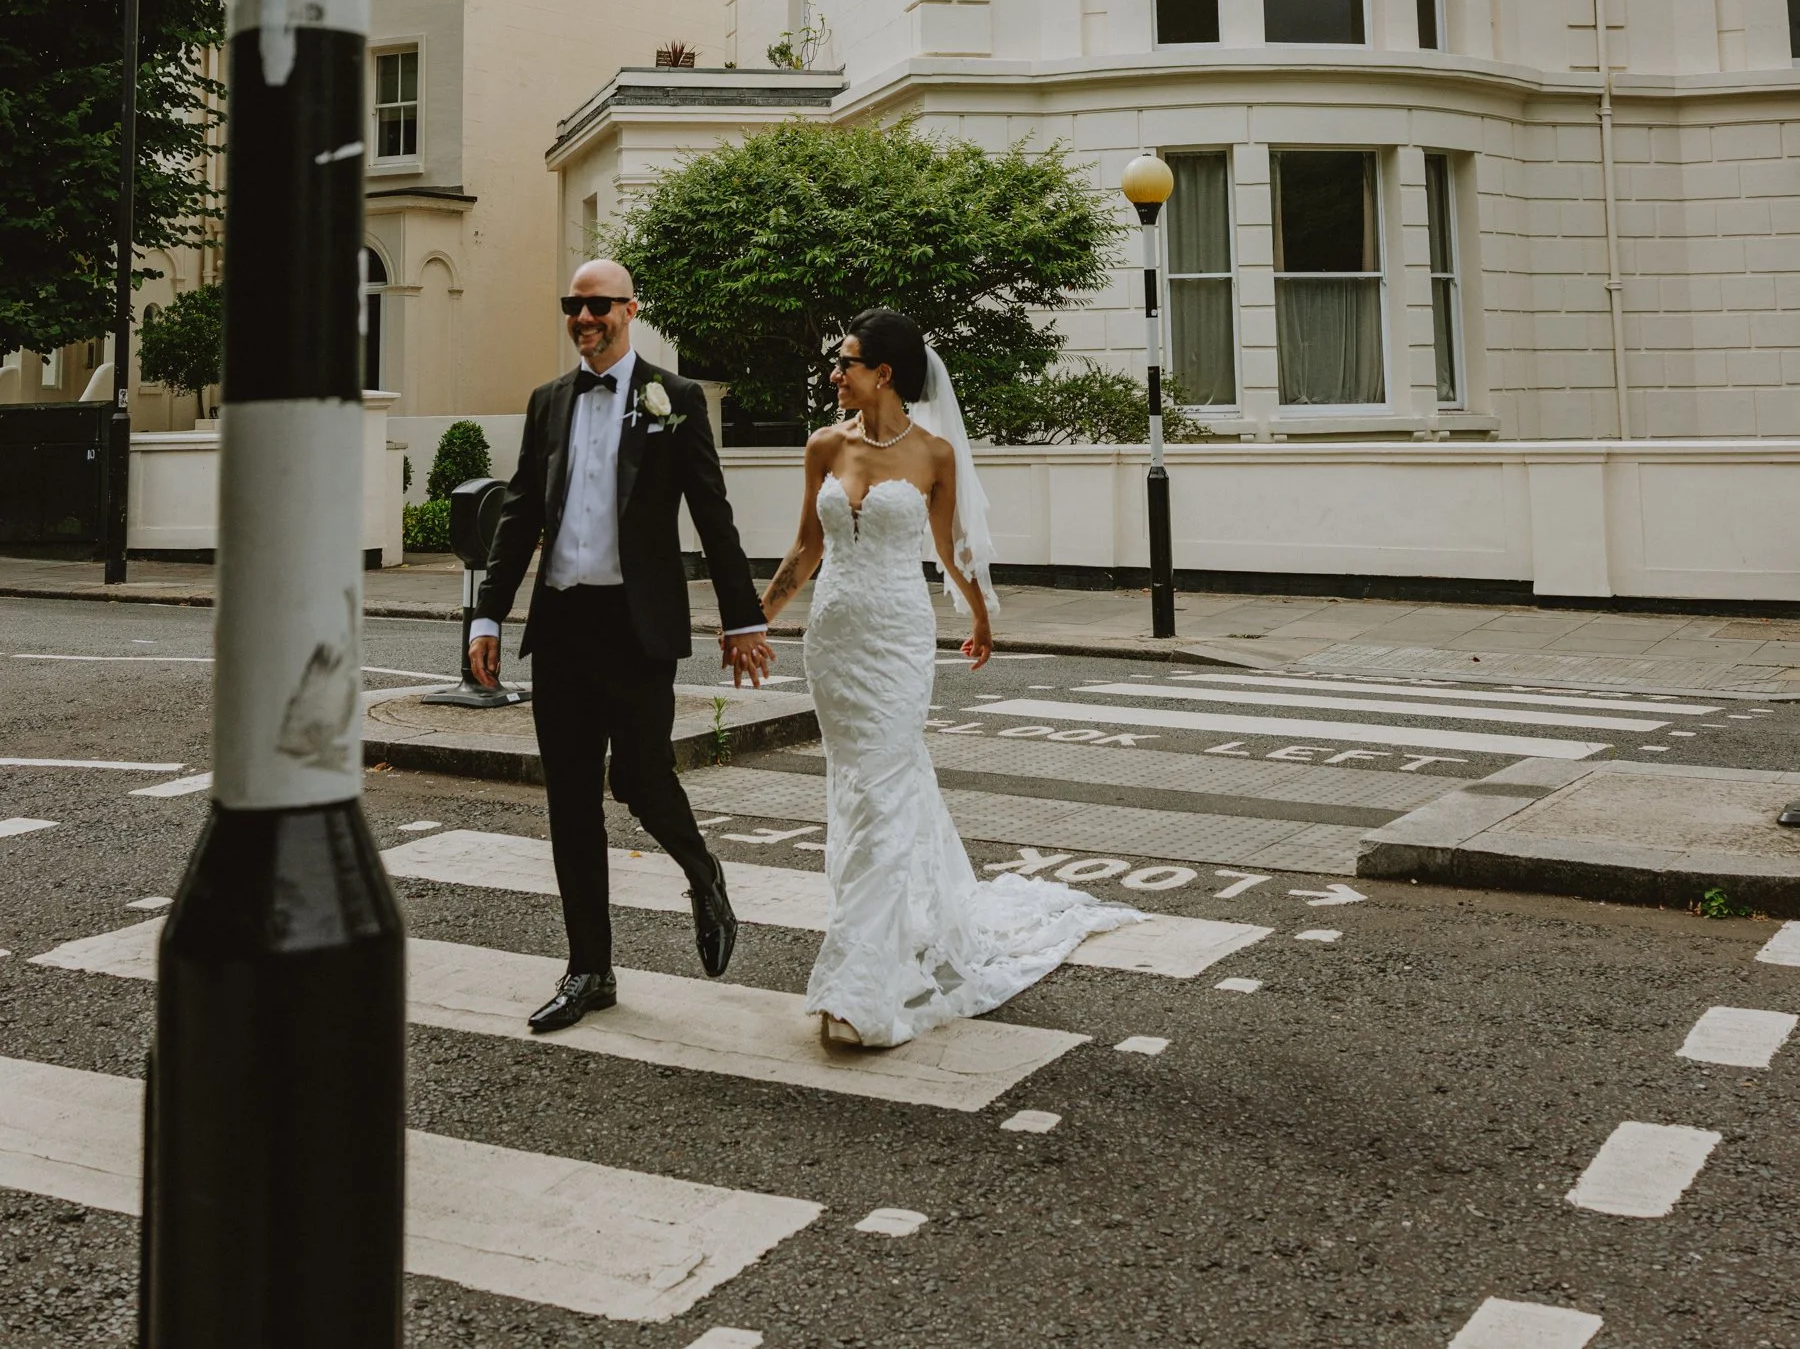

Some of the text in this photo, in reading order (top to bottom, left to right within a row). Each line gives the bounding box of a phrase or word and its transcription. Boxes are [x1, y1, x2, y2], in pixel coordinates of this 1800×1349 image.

[937, 722, 1468, 771] LOOK LEFT
[983, 848, 1272, 899] LOOK
